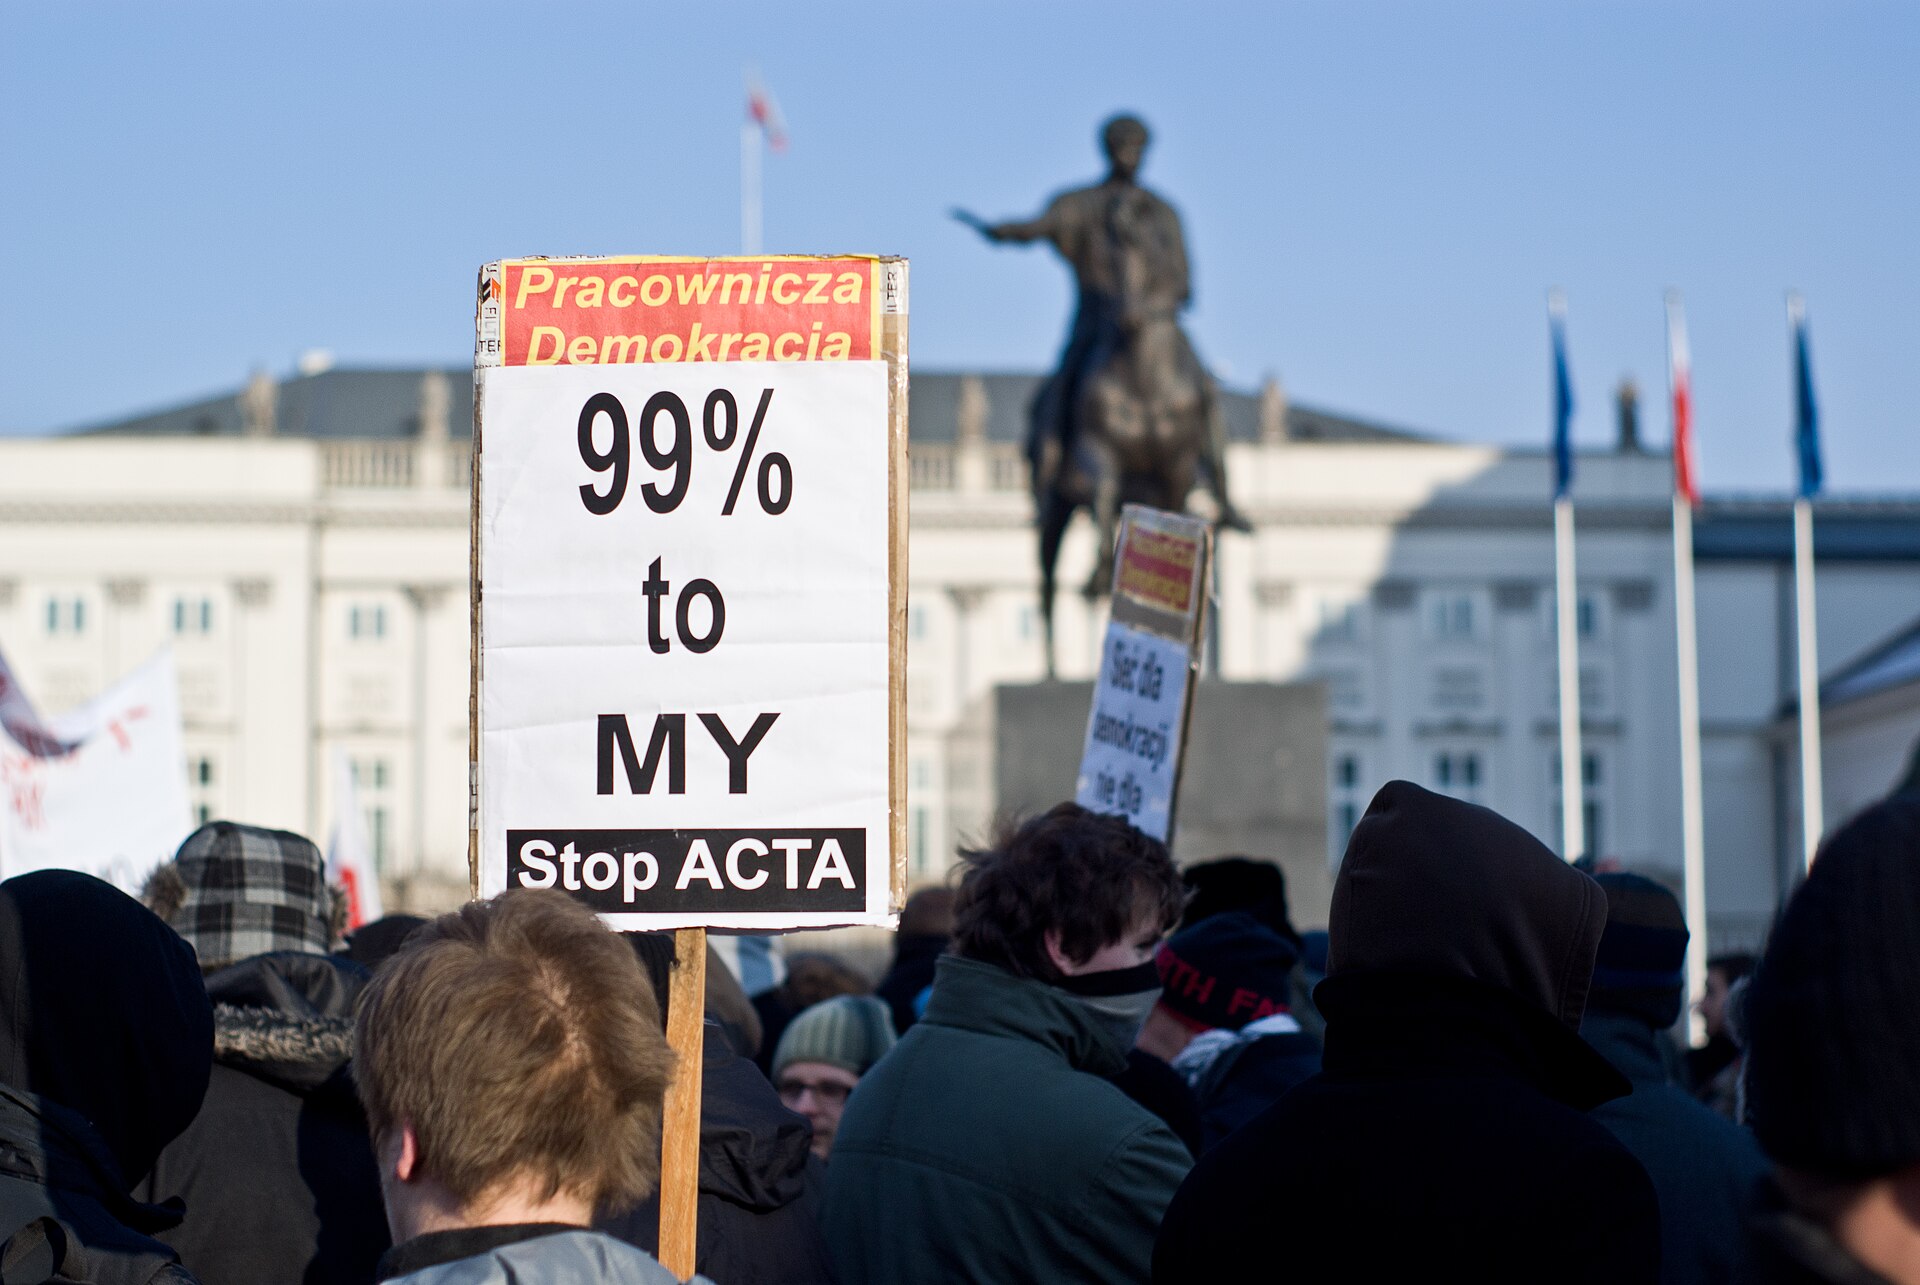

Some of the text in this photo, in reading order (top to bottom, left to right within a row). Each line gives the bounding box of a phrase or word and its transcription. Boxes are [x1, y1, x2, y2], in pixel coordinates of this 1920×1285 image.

[514, 263, 864, 310] Pracownicza
[577, 388, 793, 516] 99%
[642, 555, 726, 655] to
[596, 712, 782, 796] MY
[517, 837, 857, 903] Stop ACTA
